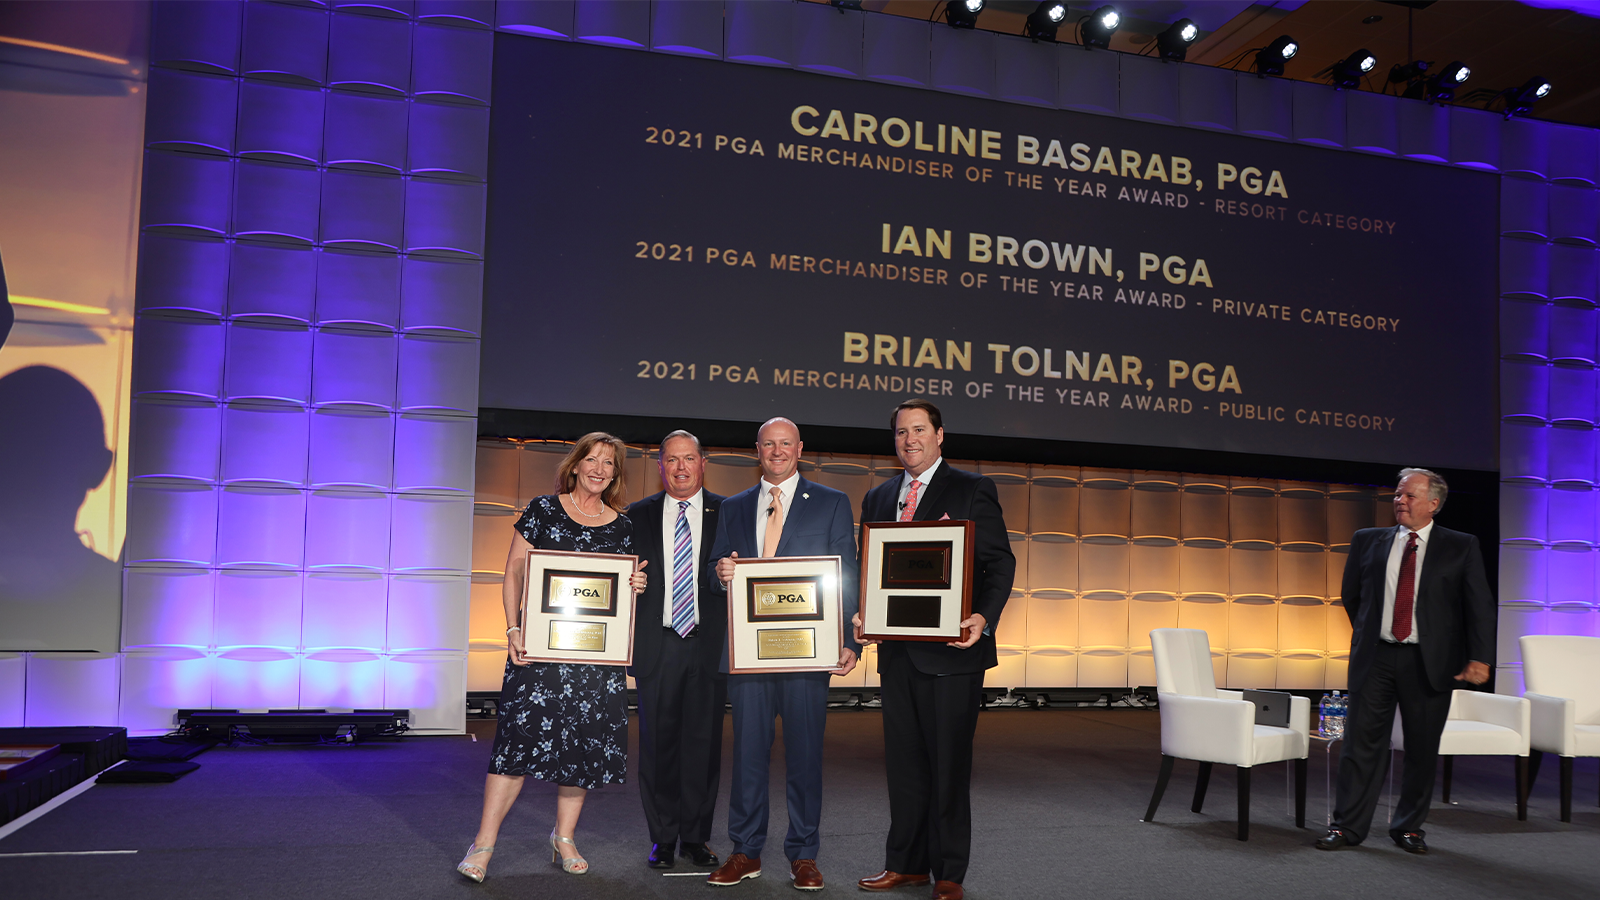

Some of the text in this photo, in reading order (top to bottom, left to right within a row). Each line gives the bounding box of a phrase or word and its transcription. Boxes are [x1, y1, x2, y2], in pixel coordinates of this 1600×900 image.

[644, 126, 703, 150] 2021
[714, 134, 766, 157] PGA
[777, 142, 954, 180] MERCHANDISER
[965, 165, 993, 184] OF
[1004, 170, 1043, 191] THE
[1053, 176, 1107, 199] YEAR
[1117, 185, 1189, 209] AWARD
[1215, 198, 1287, 221] RESORT
[1297, 209, 1396, 235] CATEGORY
[790, 104, 1289, 199] CAROLINE BASARAB, PGA
[634, 240, 694, 263] 2021
[705, 247, 757, 268] PGA
[769, 252, 949, 286] MERCHANDISER
[959, 271, 988, 289] OF
[999, 275, 1039, 295] THE
[1049, 280, 1104, 302] YEAR
[1113, 287, 1187, 310] AWARD
[1212, 297, 1291, 322] PRIVATE
[1300, 307, 1401, 333] CATEGORY
[881, 222, 1214, 289] IAN BROWN, PGA
[636, 359, 697, 381] 2021
[708, 363, 761, 384] PGA
[773, 367, 954, 397] MERCHANDISER
[964, 381, 994, 399] OF
[1004, 383, 1045, 403] THE
[1055, 387, 1110, 408] YEAR
[1120, 393, 1193, 415] AWARD
[1219, 401, 1286, 423] PUBLIC
[1295, 408, 1396, 432] CATEGORY
[842, 331, 1243, 395] BRIAN TOLNAR, PGA
[573, 588, 600, 598] PGA
[907, 560, 934, 569] PGA
[777, 594, 806, 604] PGA
